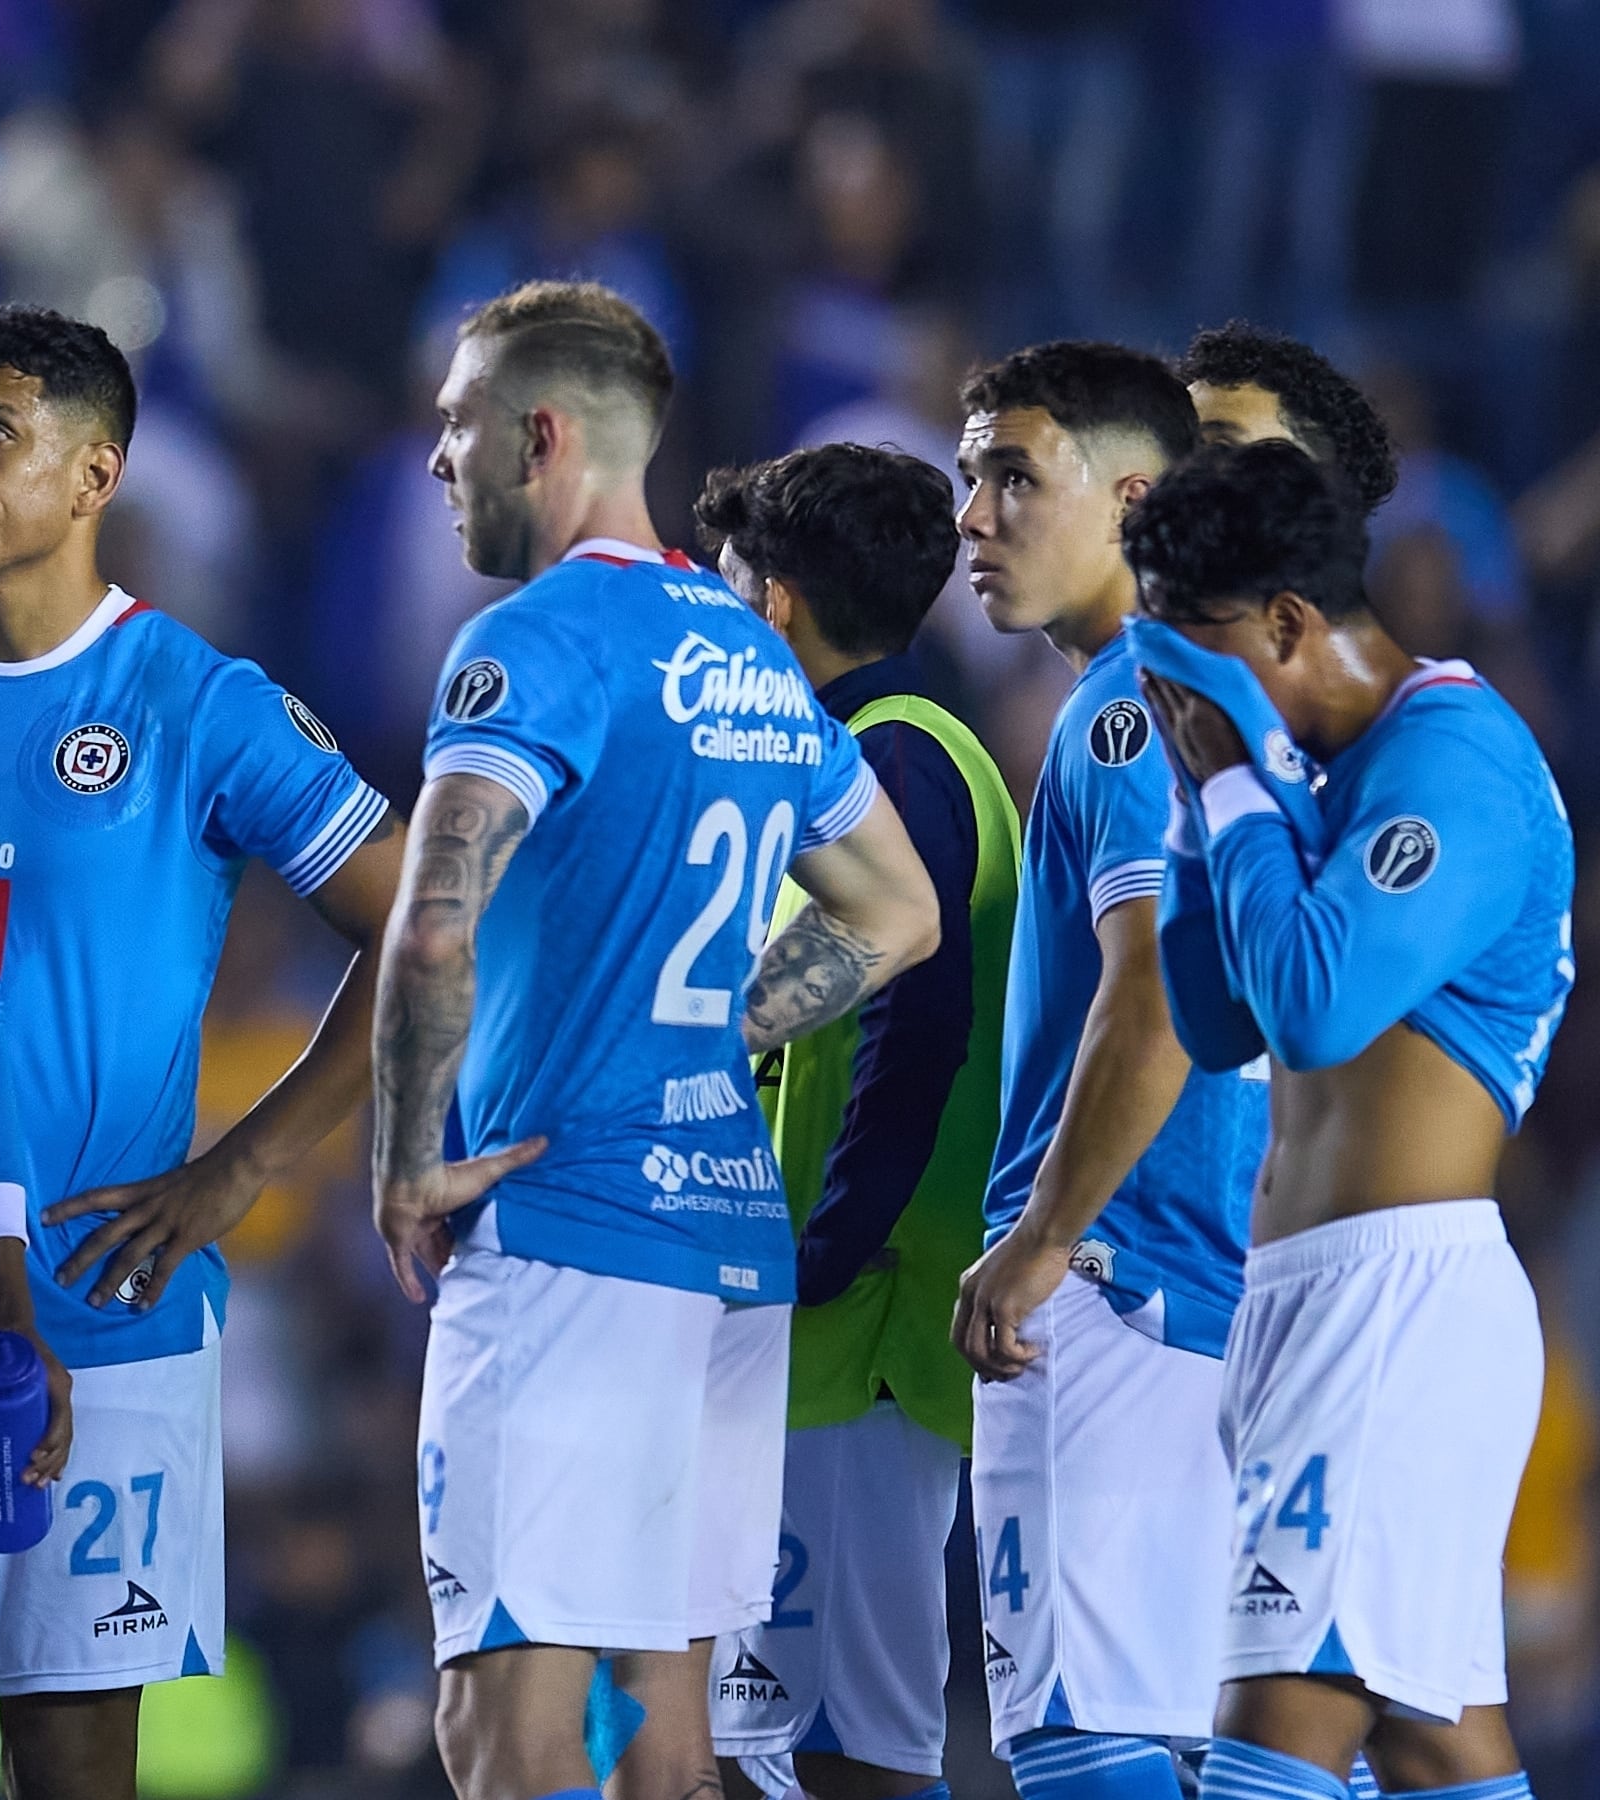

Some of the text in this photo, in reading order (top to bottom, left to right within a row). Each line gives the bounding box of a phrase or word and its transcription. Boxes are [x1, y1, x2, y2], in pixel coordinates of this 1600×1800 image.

[65, 1471, 165, 1577] 27
[94, 1611, 169, 1639] PIRMA
[719, 1682, 790, 1702] PIRMA
